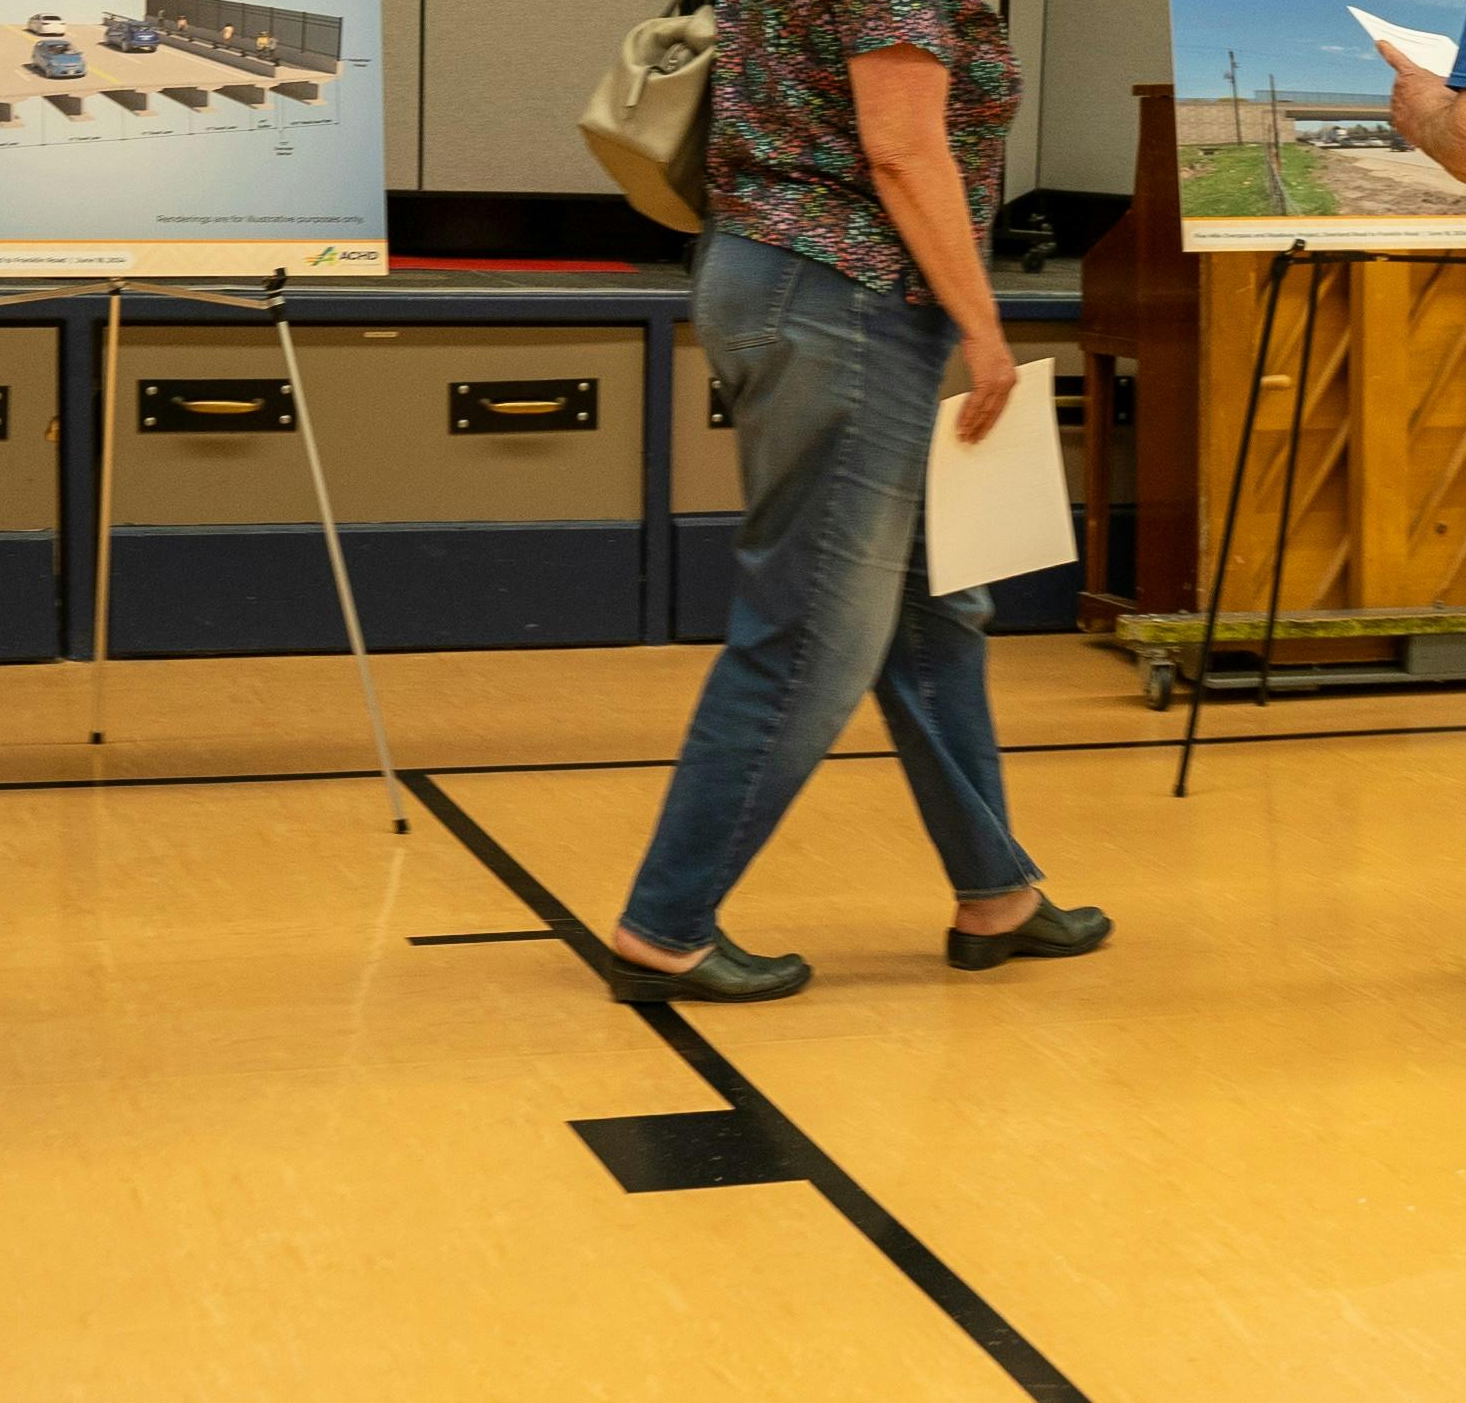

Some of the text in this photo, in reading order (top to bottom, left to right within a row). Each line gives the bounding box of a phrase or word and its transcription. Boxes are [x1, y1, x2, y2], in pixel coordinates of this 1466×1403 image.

[157, 214, 212, 225] Renderings
[247, 215, 295, 224] illustrative
[297, 216, 341, 225] purposes
[339, 251, 380, 261] ACHD
